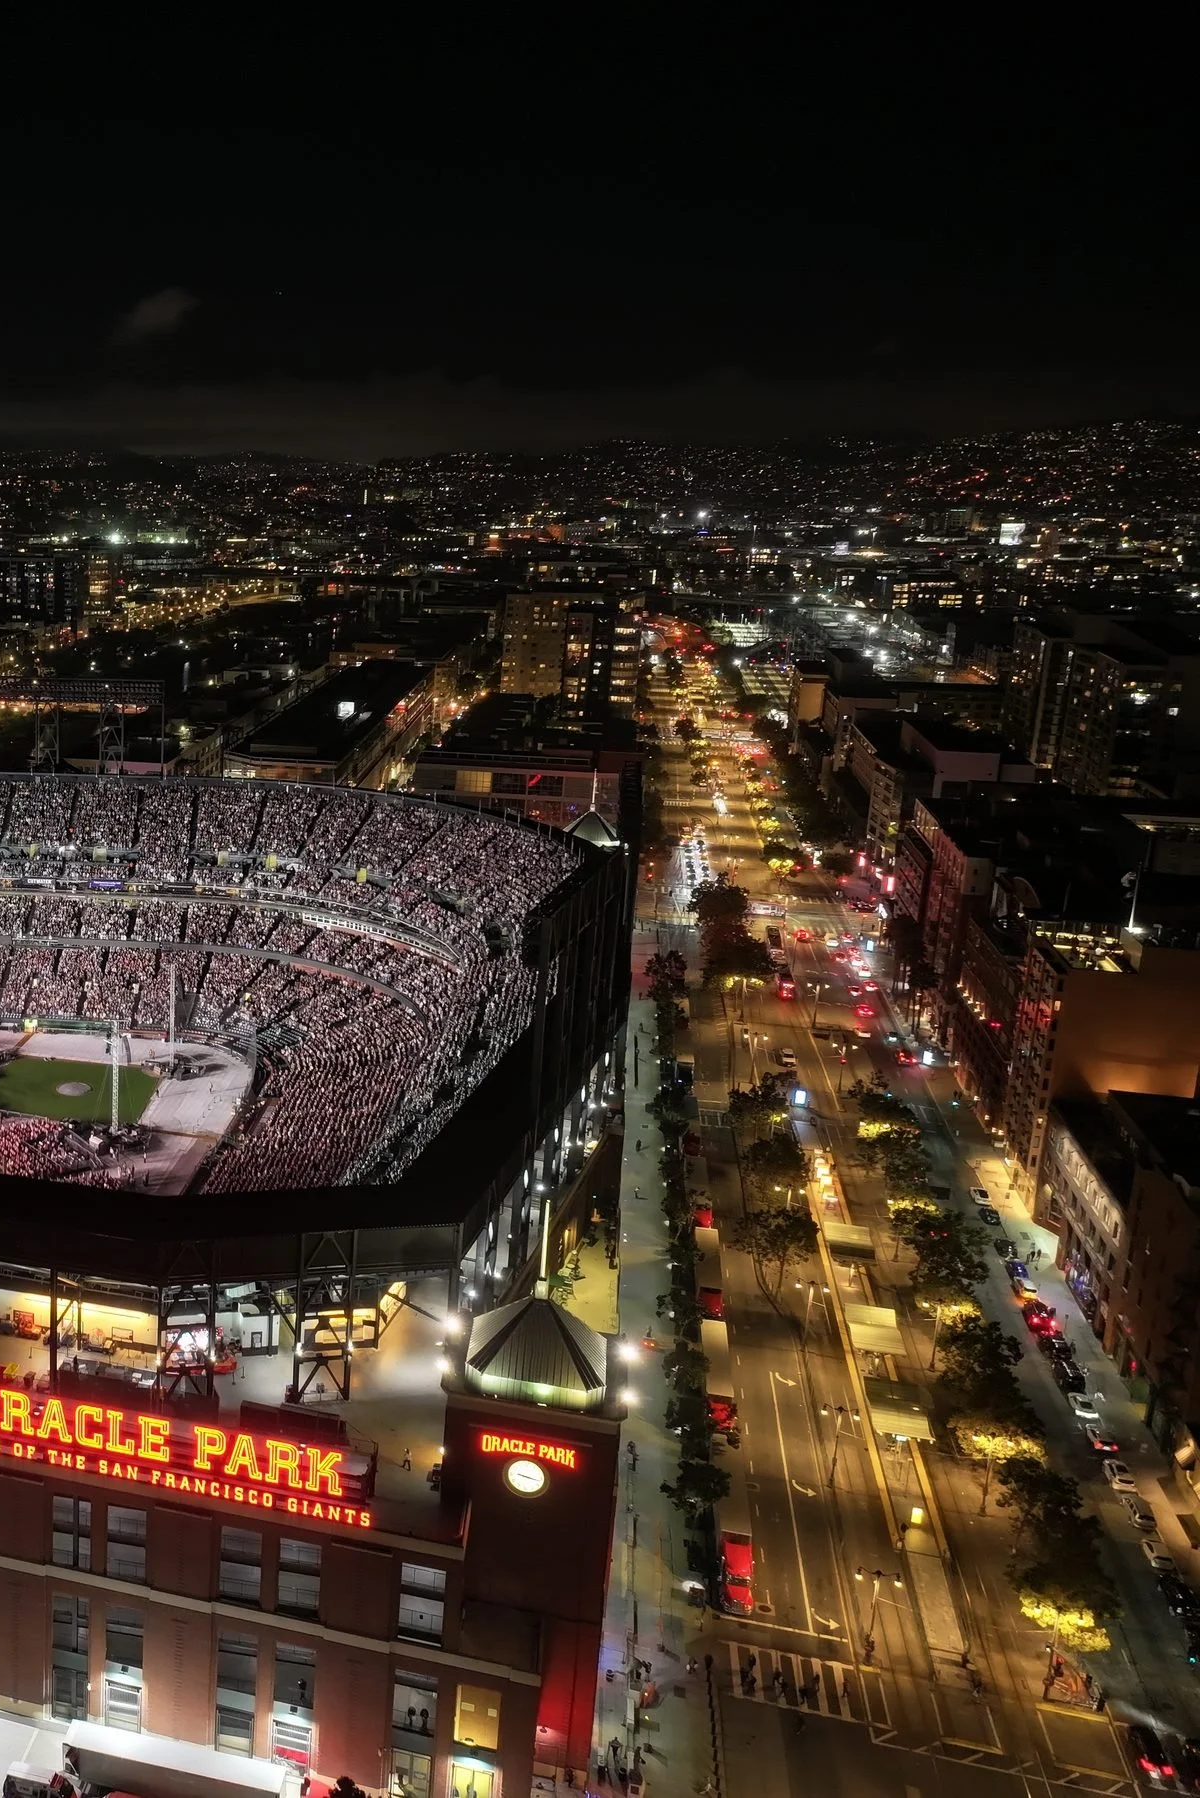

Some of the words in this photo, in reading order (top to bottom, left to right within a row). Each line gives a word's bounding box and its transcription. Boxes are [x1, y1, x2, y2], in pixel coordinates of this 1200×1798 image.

[13, 1442, 36, 1460] OF
[47, 1449, 86, 1470] THE
[98, 1459, 139, 1481] SAN
[151, 1469, 273, 1508] FRANCISCO
[287, 1497, 370, 1527] GIANTS
[193, 1425, 343, 1497] PARK
[482, 1434, 535, 1455] ORACLE
[538, 1444, 576, 1469] PARK
